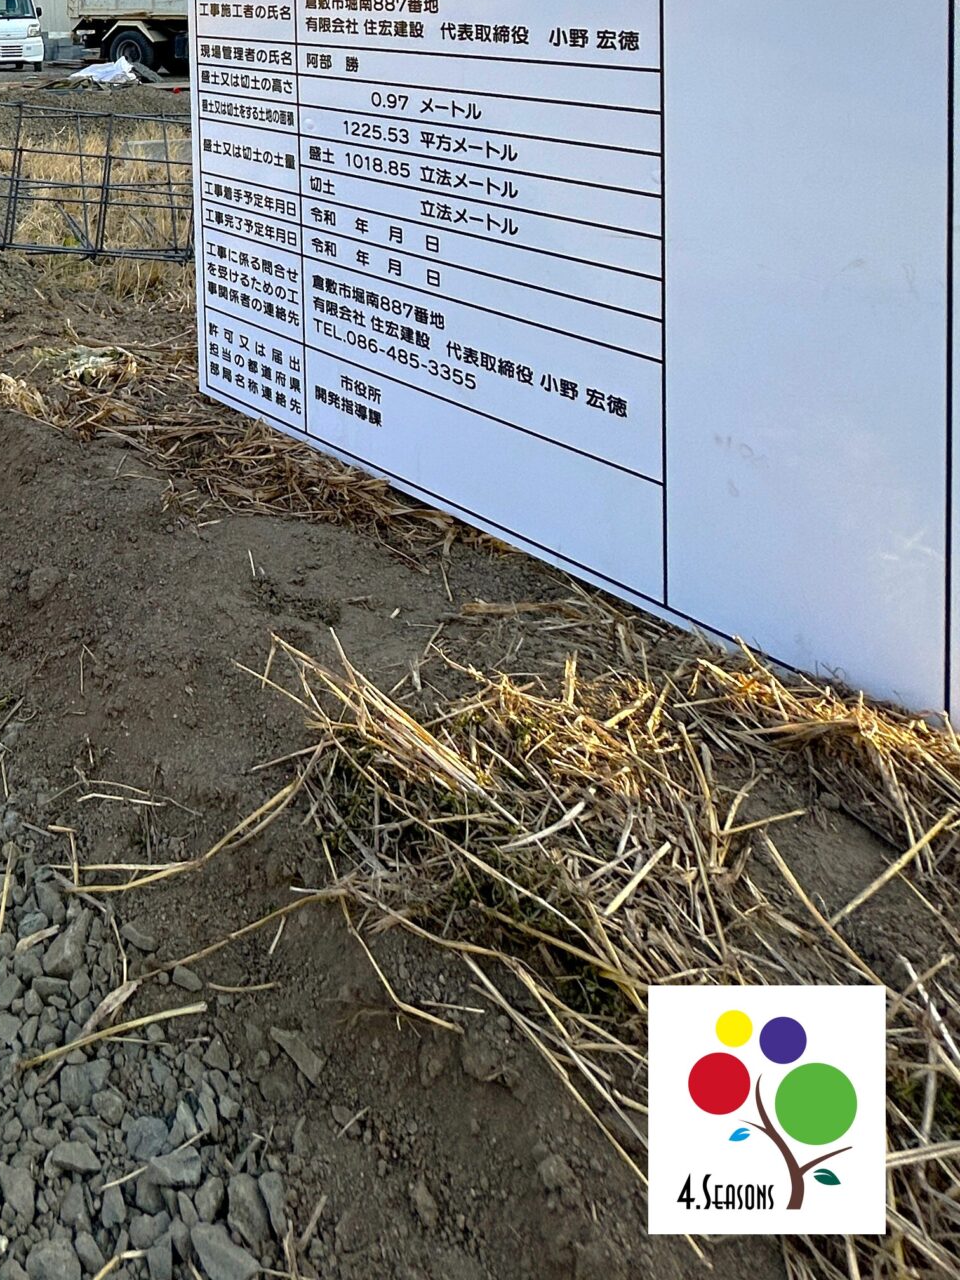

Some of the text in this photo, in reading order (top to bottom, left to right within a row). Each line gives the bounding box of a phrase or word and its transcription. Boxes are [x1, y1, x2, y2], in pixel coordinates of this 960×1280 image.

[199, 3, 291, 20] 工事施工者の氏名
[440, 22, 529, 45] 代表取締役
[201, 44, 292, 66] 現場管理者の氏名
[201, 70, 293, 94] 盛土又は切土の高さ
[202, 99, 295, 126] 盛土又は切土をする土地の面積
[371, 92, 482, 120] 0.97 メートル
[203, 138, 296, 170] 盛土又は切土の土量
[343, 120, 519, 162] 1225.53 平方メートル
[309, 145, 519, 199] 盛土 1018.85 立法メートル
[204, 182, 296, 216] 工事着手予定年月日
[310, 176, 519, 236] 切土 立法メートル
[205, 208, 297, 246] 工事完了予定年月日
[310, 206, 439, 253] 令和 年 月 日
[206, 241, 298, 283] 工事に係る問合せ
[311, 237, 440, 287] 令和 年 月 日
[207, 262, 298, 306] を受けるための工
[207, 281, 299, 327] 事関係者の連絡先
[312, 274, 445, 330] 倉敷市堀南887番地
[313, 318, 477, 390] TEL.086-485-3355
[446, 340, 534, 386] 代表取締役
[315, 385, 382, 427] 開発指導課
[340, 375, 381, 404] 市役所
